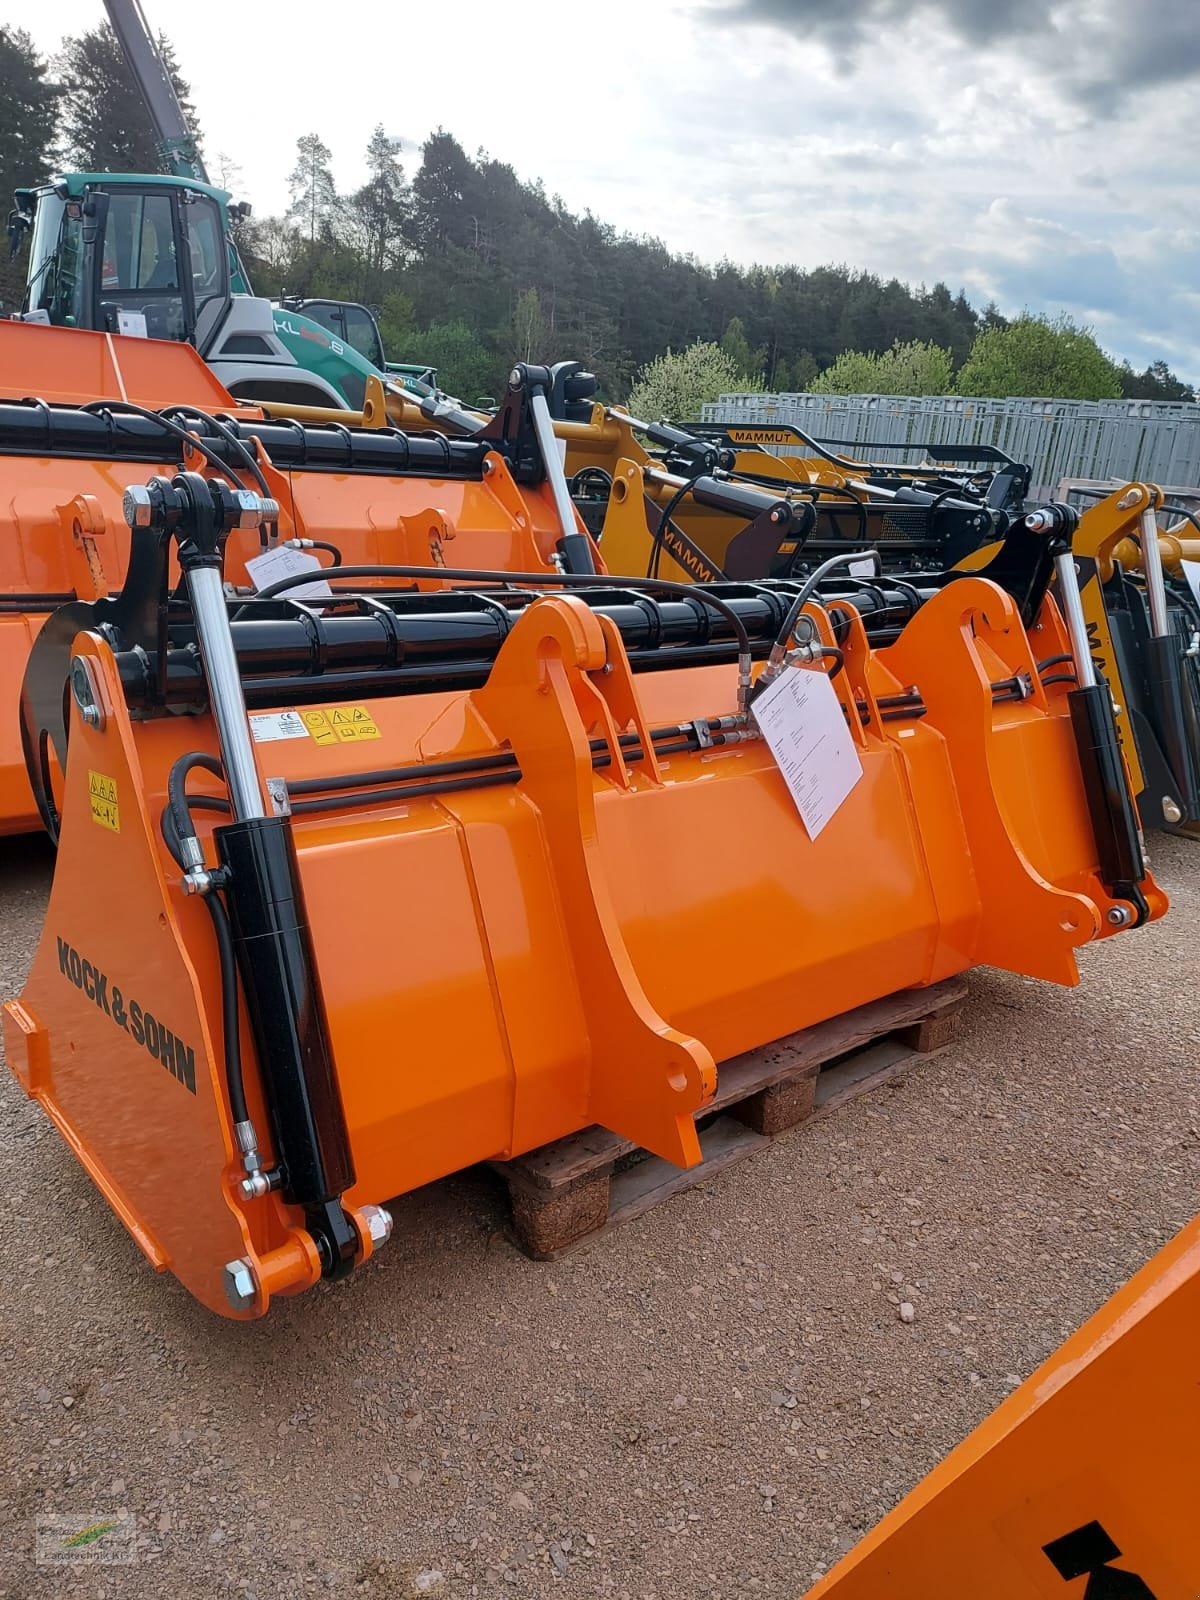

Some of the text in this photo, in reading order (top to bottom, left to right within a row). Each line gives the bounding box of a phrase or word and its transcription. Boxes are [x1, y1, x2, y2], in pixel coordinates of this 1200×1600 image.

[735, 432, 792, 443] MAMMUT
[664, 525, 716, 582] MAMM
[56, 935, 197, 1096] KOCK & SOHN
